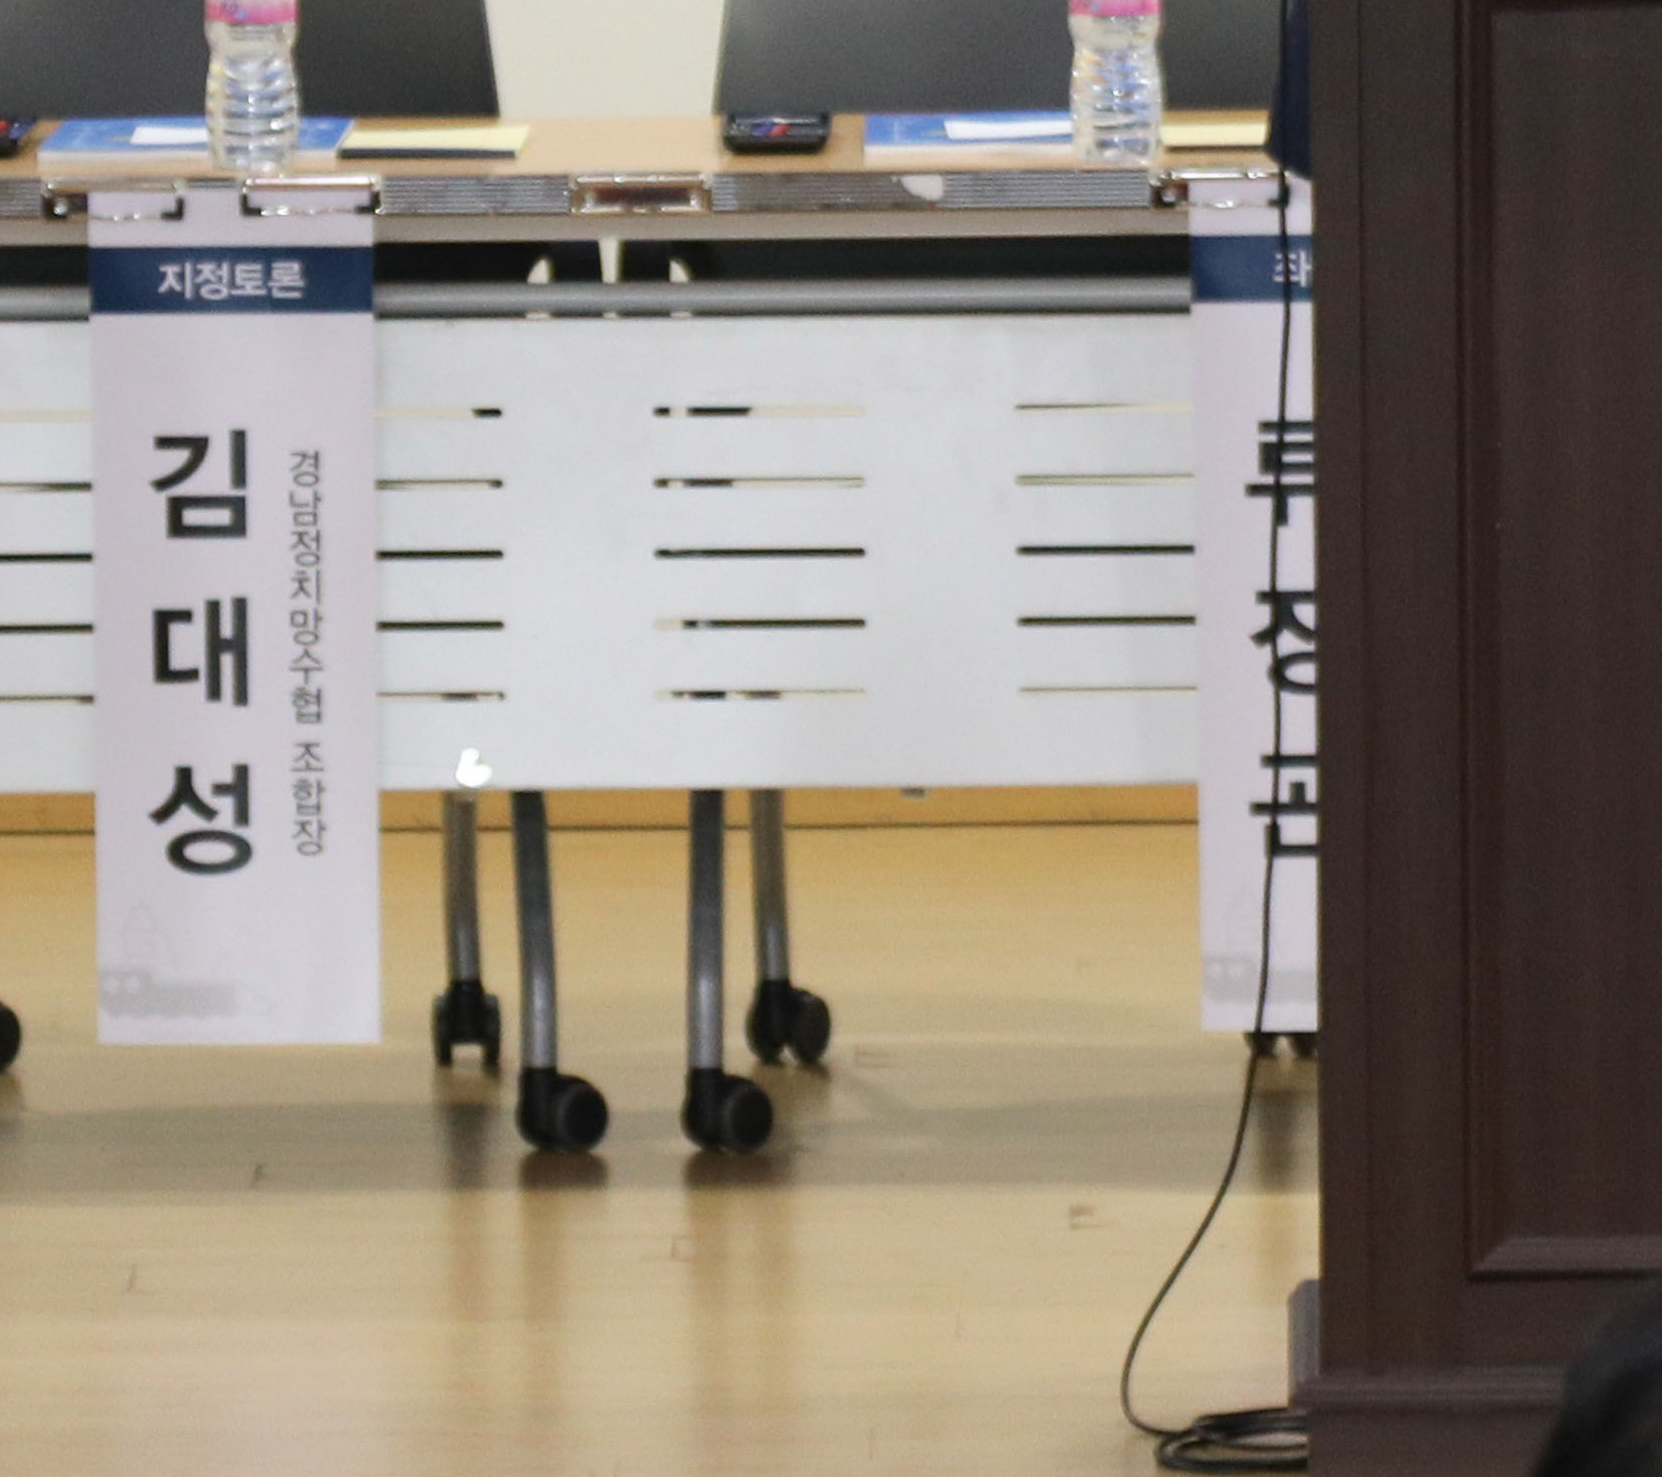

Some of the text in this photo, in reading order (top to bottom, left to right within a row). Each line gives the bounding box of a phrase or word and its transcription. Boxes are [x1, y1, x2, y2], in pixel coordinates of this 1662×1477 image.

[157, 259, 306, 302] 지정토론
[148, 428, 254, 876] 김대성
[288, 449, 327, 858] 경남정치망수협 조합장
